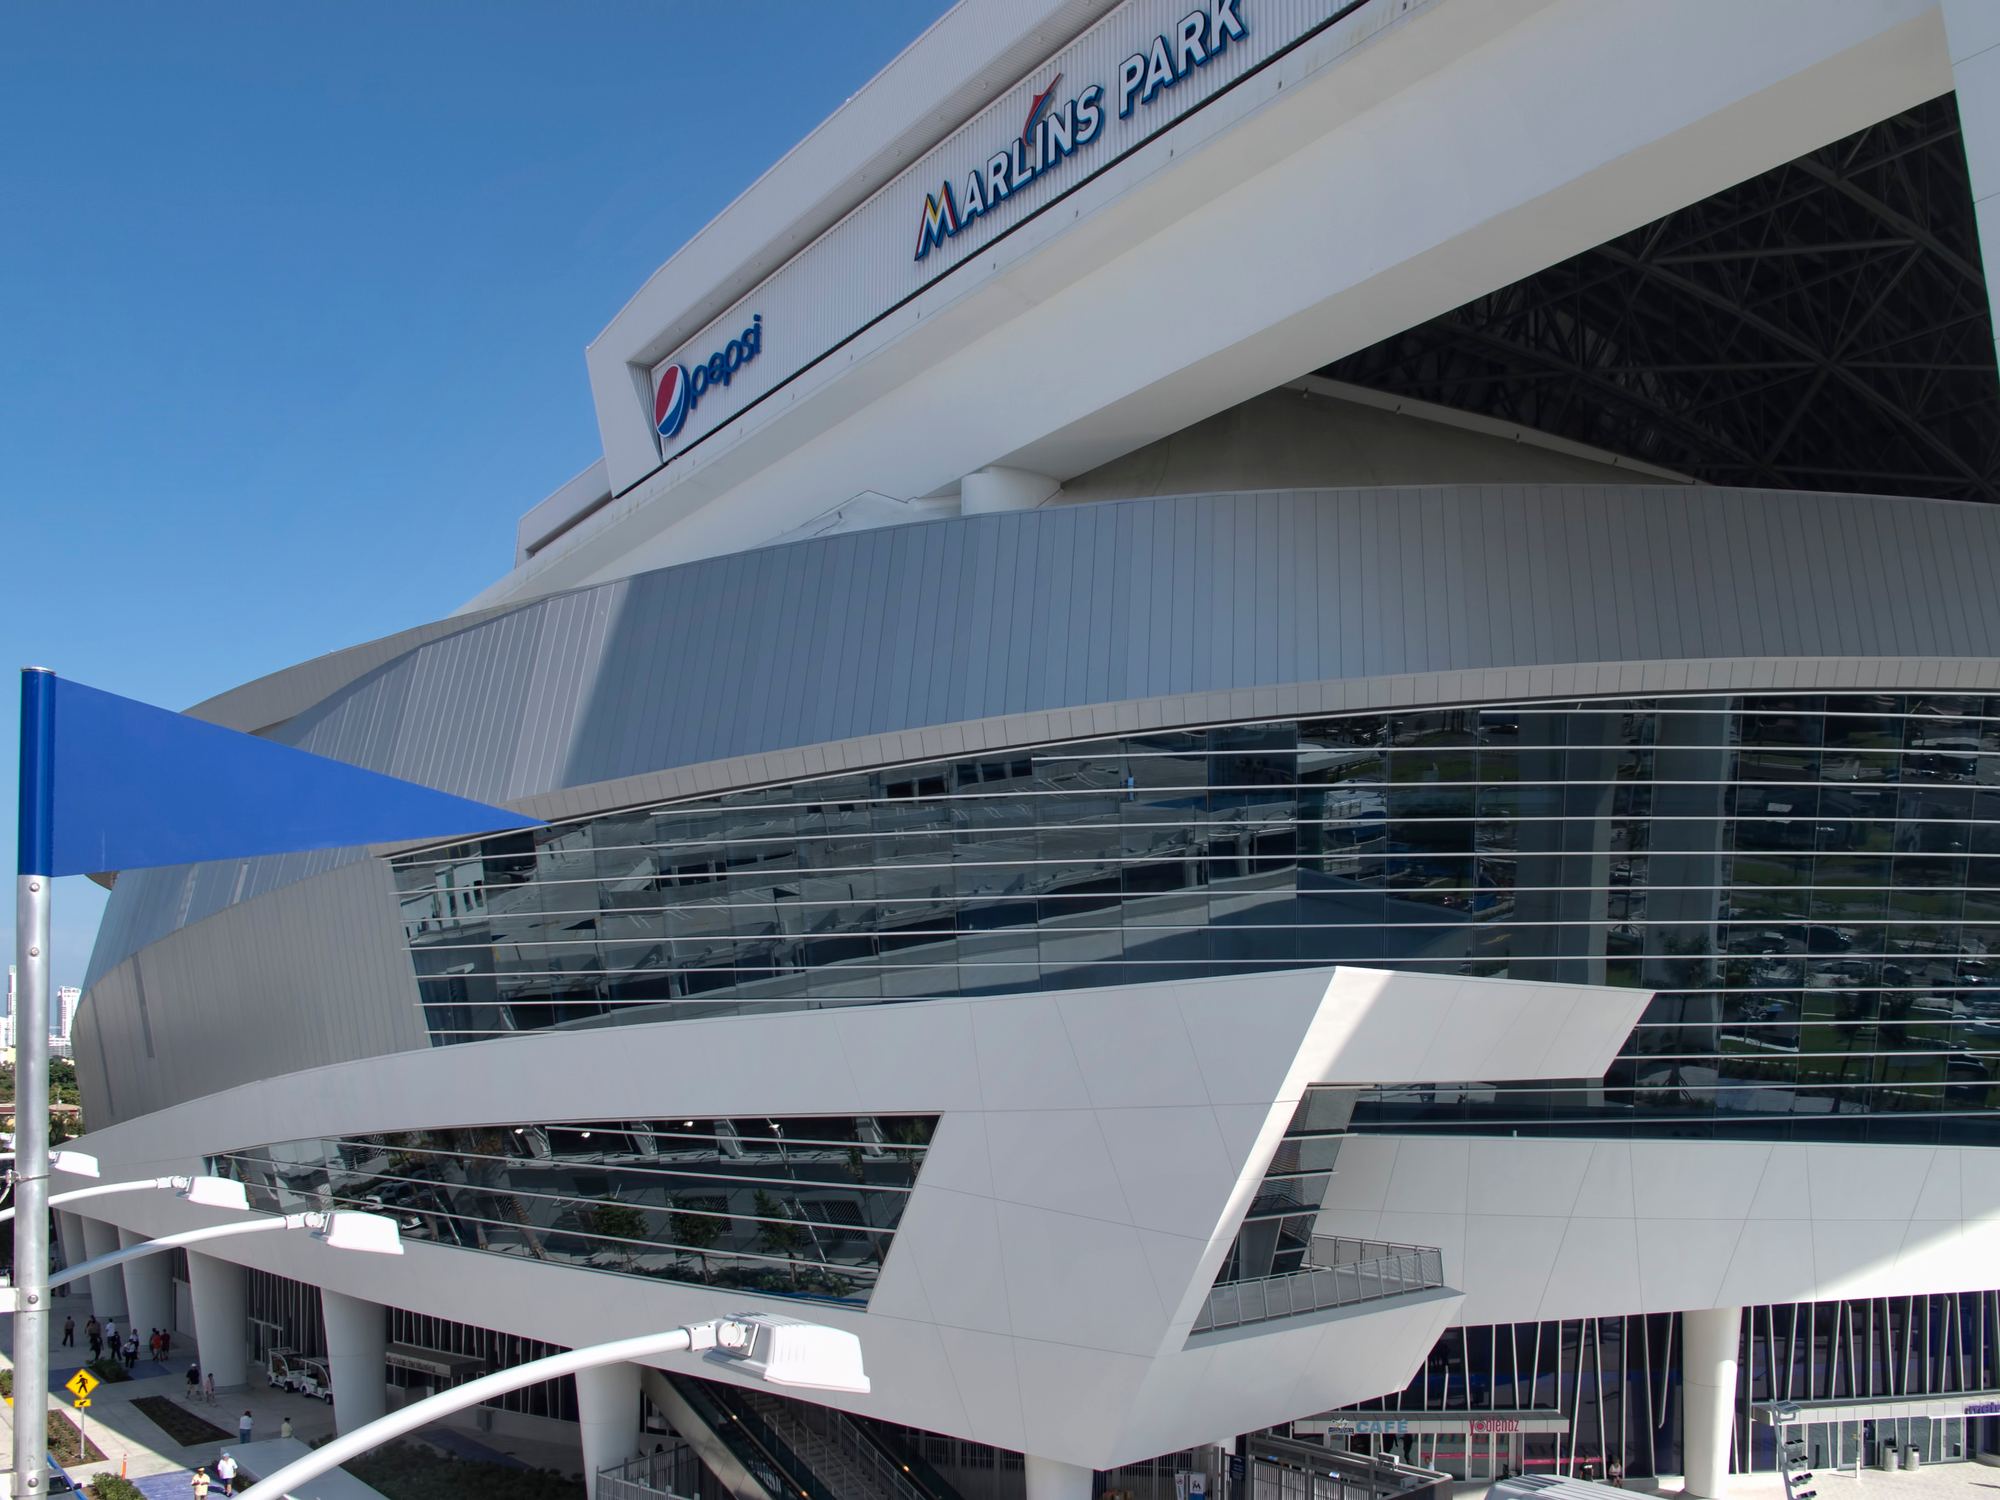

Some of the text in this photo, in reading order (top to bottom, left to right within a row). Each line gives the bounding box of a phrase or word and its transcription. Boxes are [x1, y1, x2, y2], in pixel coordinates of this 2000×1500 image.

[914, 0, 1250, 262] MARLINS PARK
[690, 313, 762, 410] pepsi
[1356, 1418, 1408, 1433] CAFÉ
